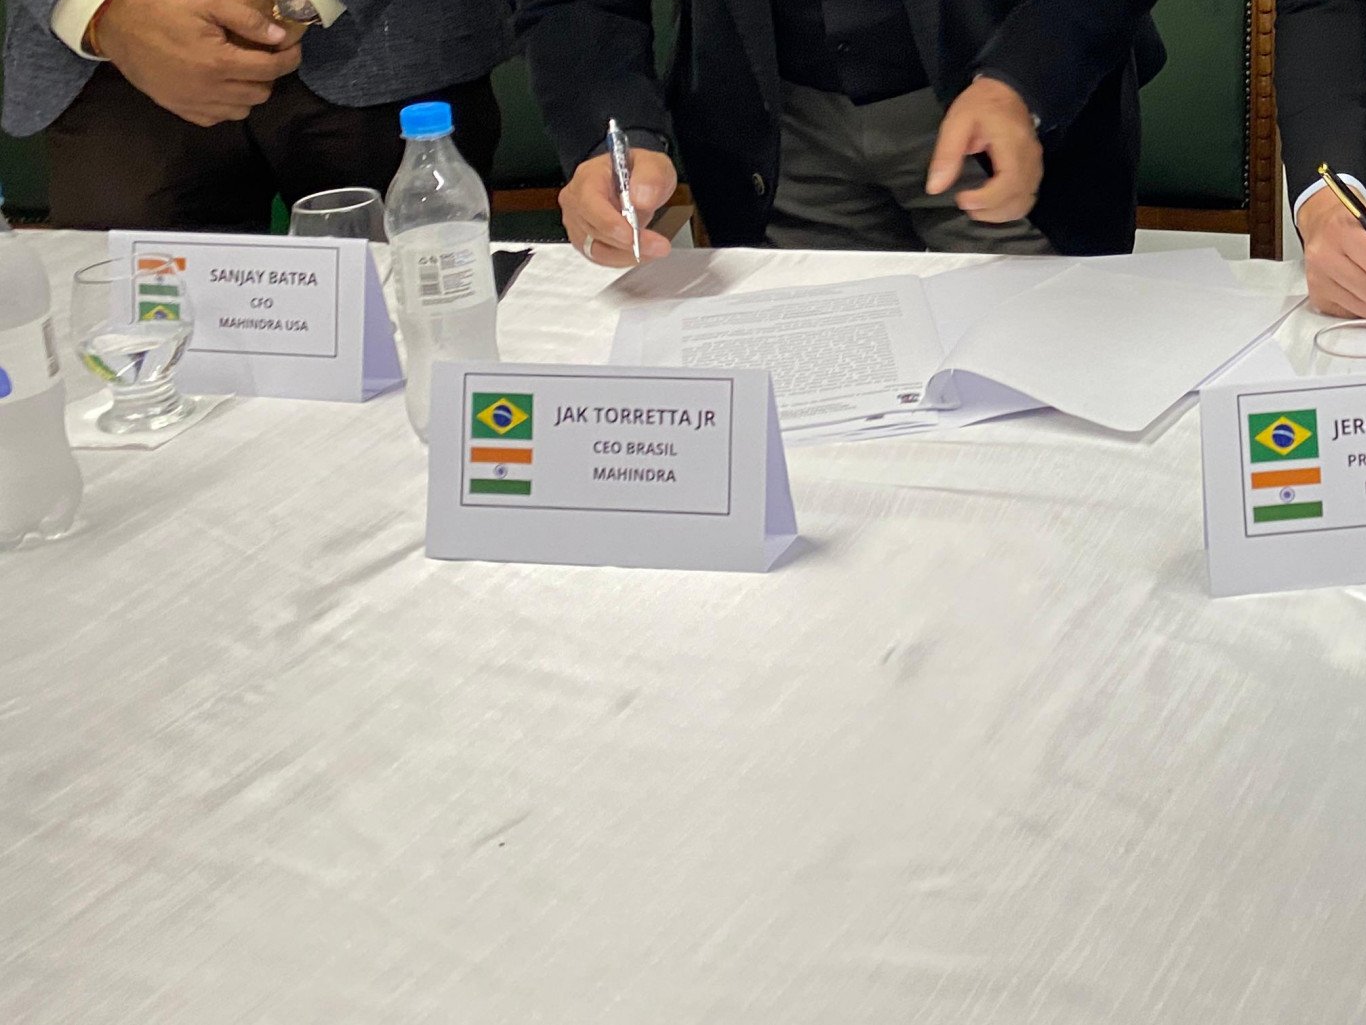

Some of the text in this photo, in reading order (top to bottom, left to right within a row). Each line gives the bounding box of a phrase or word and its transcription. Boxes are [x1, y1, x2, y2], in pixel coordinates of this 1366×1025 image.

[210, 269, 317, 286] SANJAY BATRA
[250, 297, 273, 309] CFO
[219, 317, 308, 331] MAHINDRA USA
[554, 406, 717, 430] JAK TORRETTA JR
[593, 440, 677, 456] CEO BRASIL
[593, 467, 677, 482] MAHINDRA
